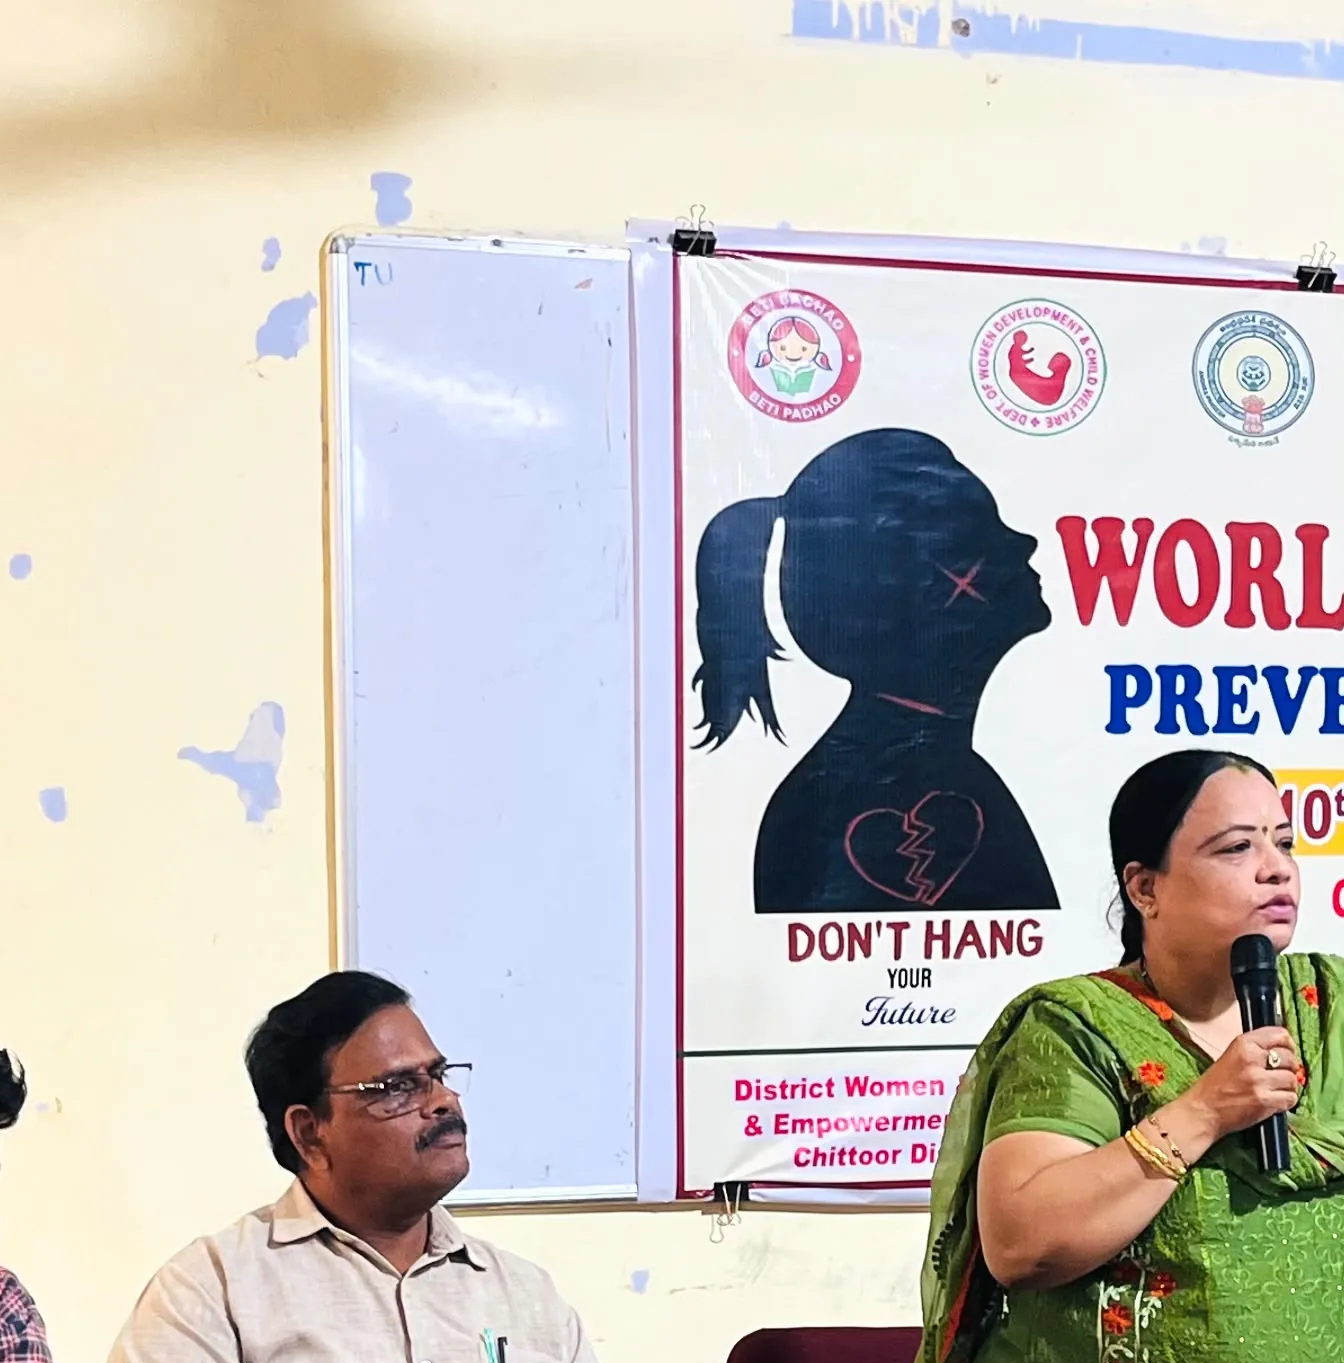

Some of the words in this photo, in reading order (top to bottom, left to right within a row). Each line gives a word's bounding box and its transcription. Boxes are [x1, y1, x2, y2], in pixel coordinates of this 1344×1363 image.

[993, 306, 1084, 335] DEVELOPMENT
[978, 330, 997, 380] WOMEN
[1085, 347, 1098, 386] CHILD
[783, 393, 841, 419] PADHAO
[981, 384, 998, 400] OF
[1046, 388, 1095, 428] WELFARE
[788, 920, 911, 962] DON'T
[924, 918, 1043, 960] HANG
[887, 968, 932, 989] YOUR
[861, 997, 956, 1026] Future
[735, 1077, 835, 1101] District
[844, 1076, 944, 1097] Women
[744, 1115, 763, 1137] &
[771, 1111, 947, 1139] Empowerme
[794, 1146, 902, 1167] Chittoor
